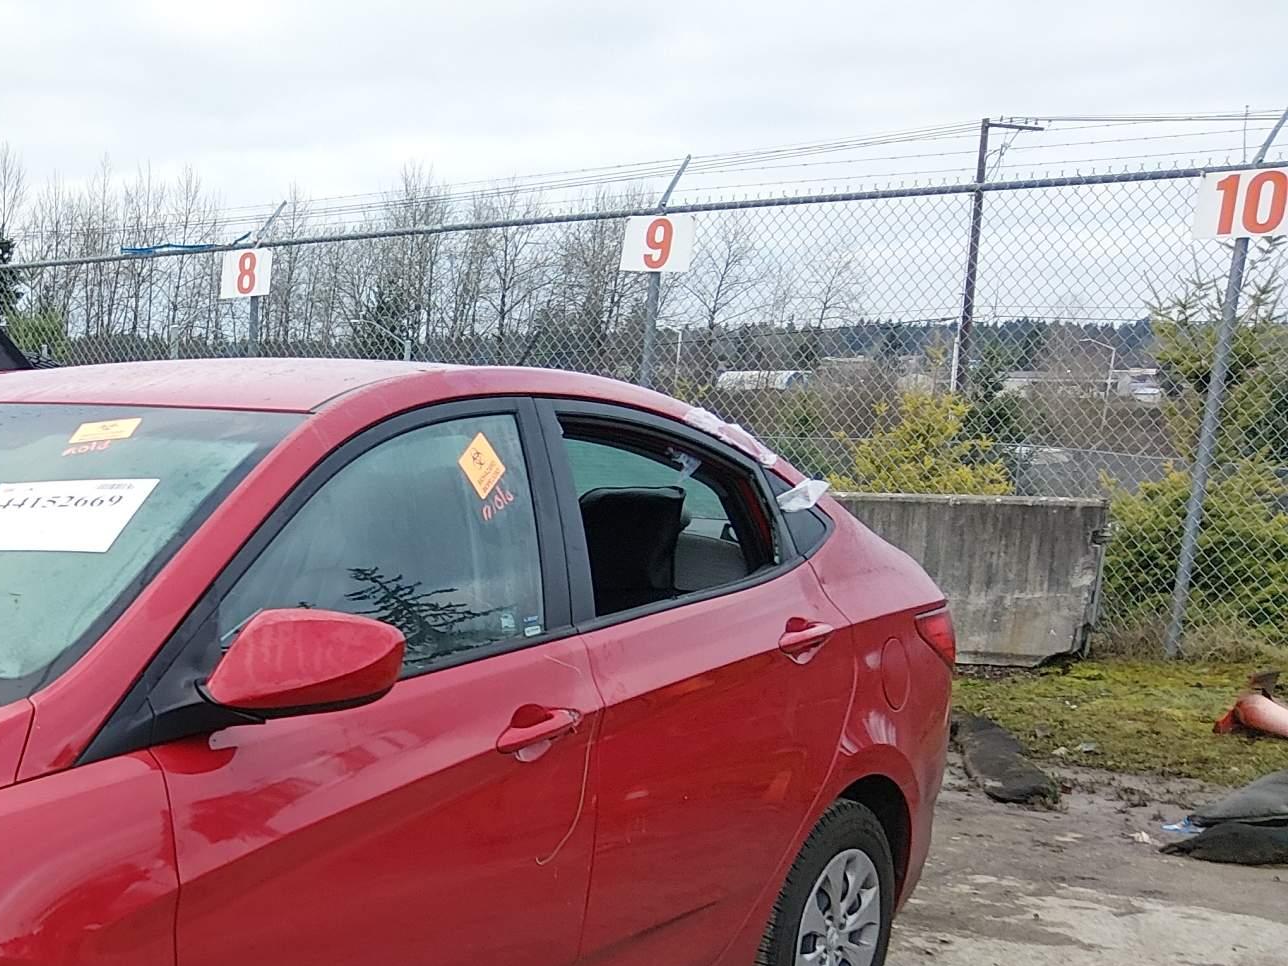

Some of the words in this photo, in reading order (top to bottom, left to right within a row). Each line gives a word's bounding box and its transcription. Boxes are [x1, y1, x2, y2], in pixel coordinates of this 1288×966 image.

[1216, 170, 1288, 235] 10
[643, 218, 673, 269] 9
[237, 251, 256, 294] 8
